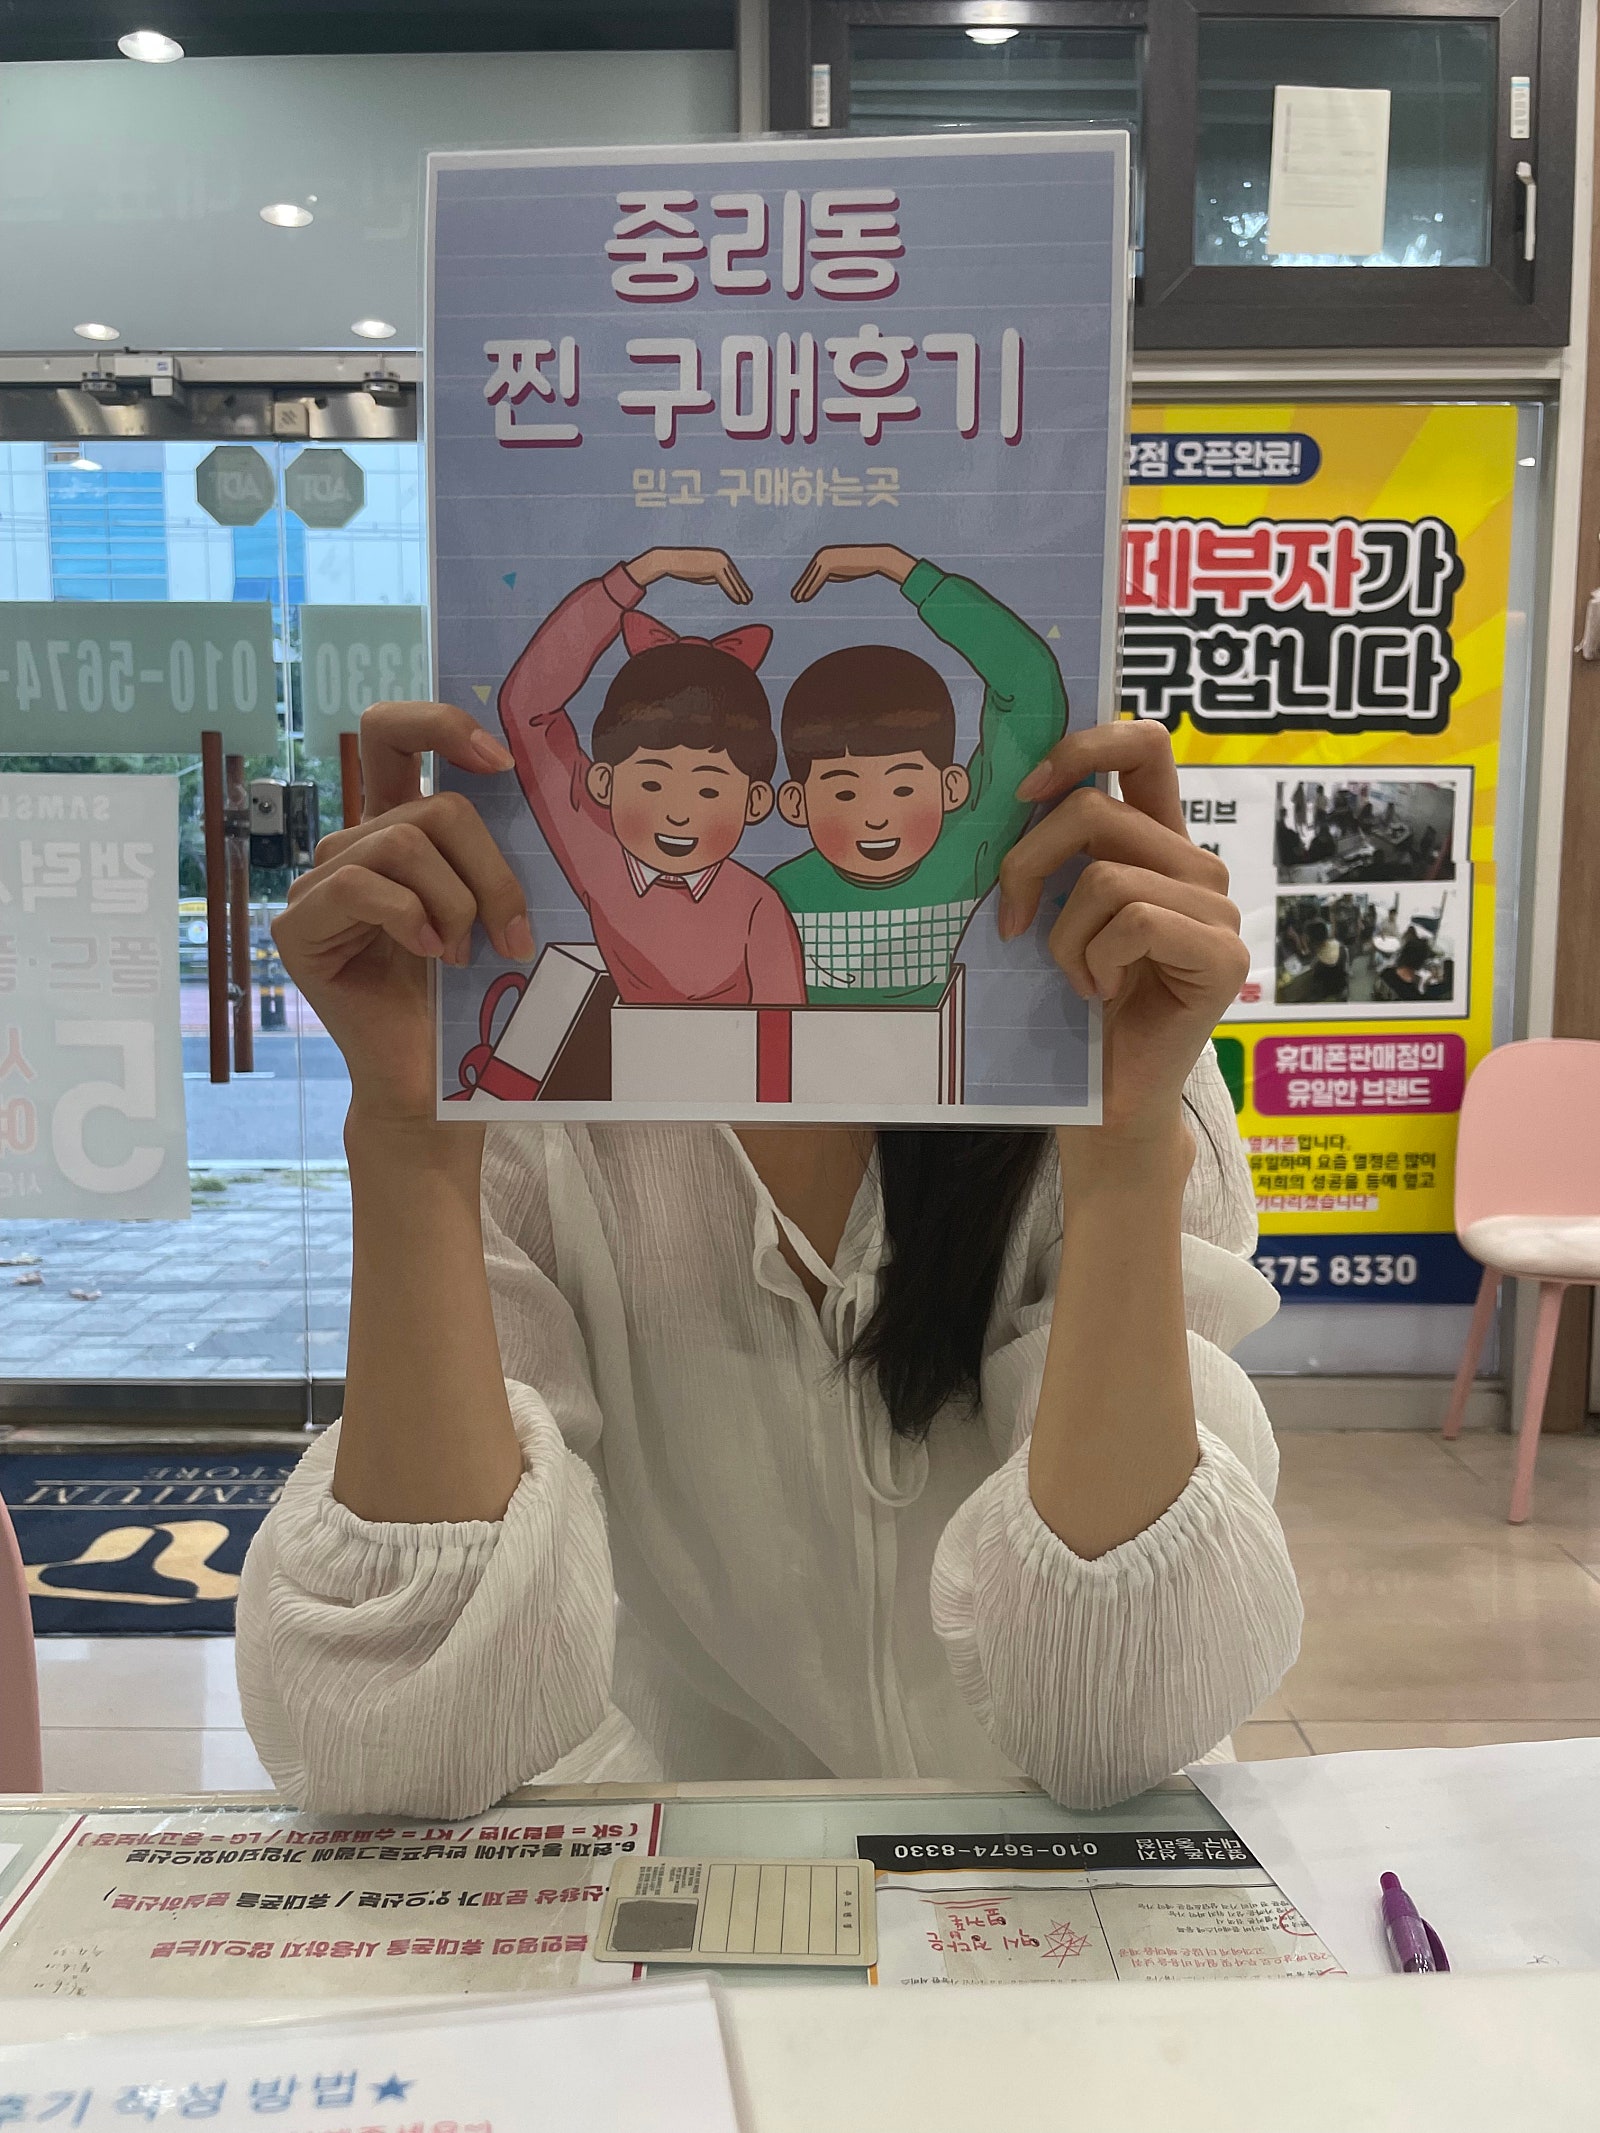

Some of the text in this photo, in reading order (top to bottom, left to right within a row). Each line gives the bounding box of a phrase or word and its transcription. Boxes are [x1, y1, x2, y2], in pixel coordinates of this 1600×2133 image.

[605, 189, 906, 303] 중리동
[484, 323, 1024, 448] 찐 구매후기
[1174, 440, 1302, 478] 오픈완료!
[632, 465, 901, 508] 믿고 구매하는곳
[1122, 624, 1450, 720] 구합니다
[1275, 1043, 1445, 1074] 휴대폰판매점의
[1287, 1077, 1432, 1109] 유일한 브랜드
[1253, 1254, 1419, 1287] 375 8330
[230, 1831, 263, 1845] LG
[286, 1829, 397, 1846] 슈퍼체인지
[420, 1828, 455, 1842] KT
[592, 1823, 624, 1839] SK
[474, 1842, 564, 1860] 통신사에
[893, 1841, 1099, 1860] 010-5674-8330
[1200, 1837, 1242, 1849] 대구
[311, 1845, 469, 1864] 반납프로그램에
[1137, 1847, 1247, 1861] 옆커폰 성지
[235, 1892, 332, 1911] 휴대폰을
[457, 1888, 529, 1908] 문제가
[151, 1933, 589, 1960] 본인명의 휴대폰을 사용하지 않으시는분
[1002, 1929, 1041, 1951] 역시
